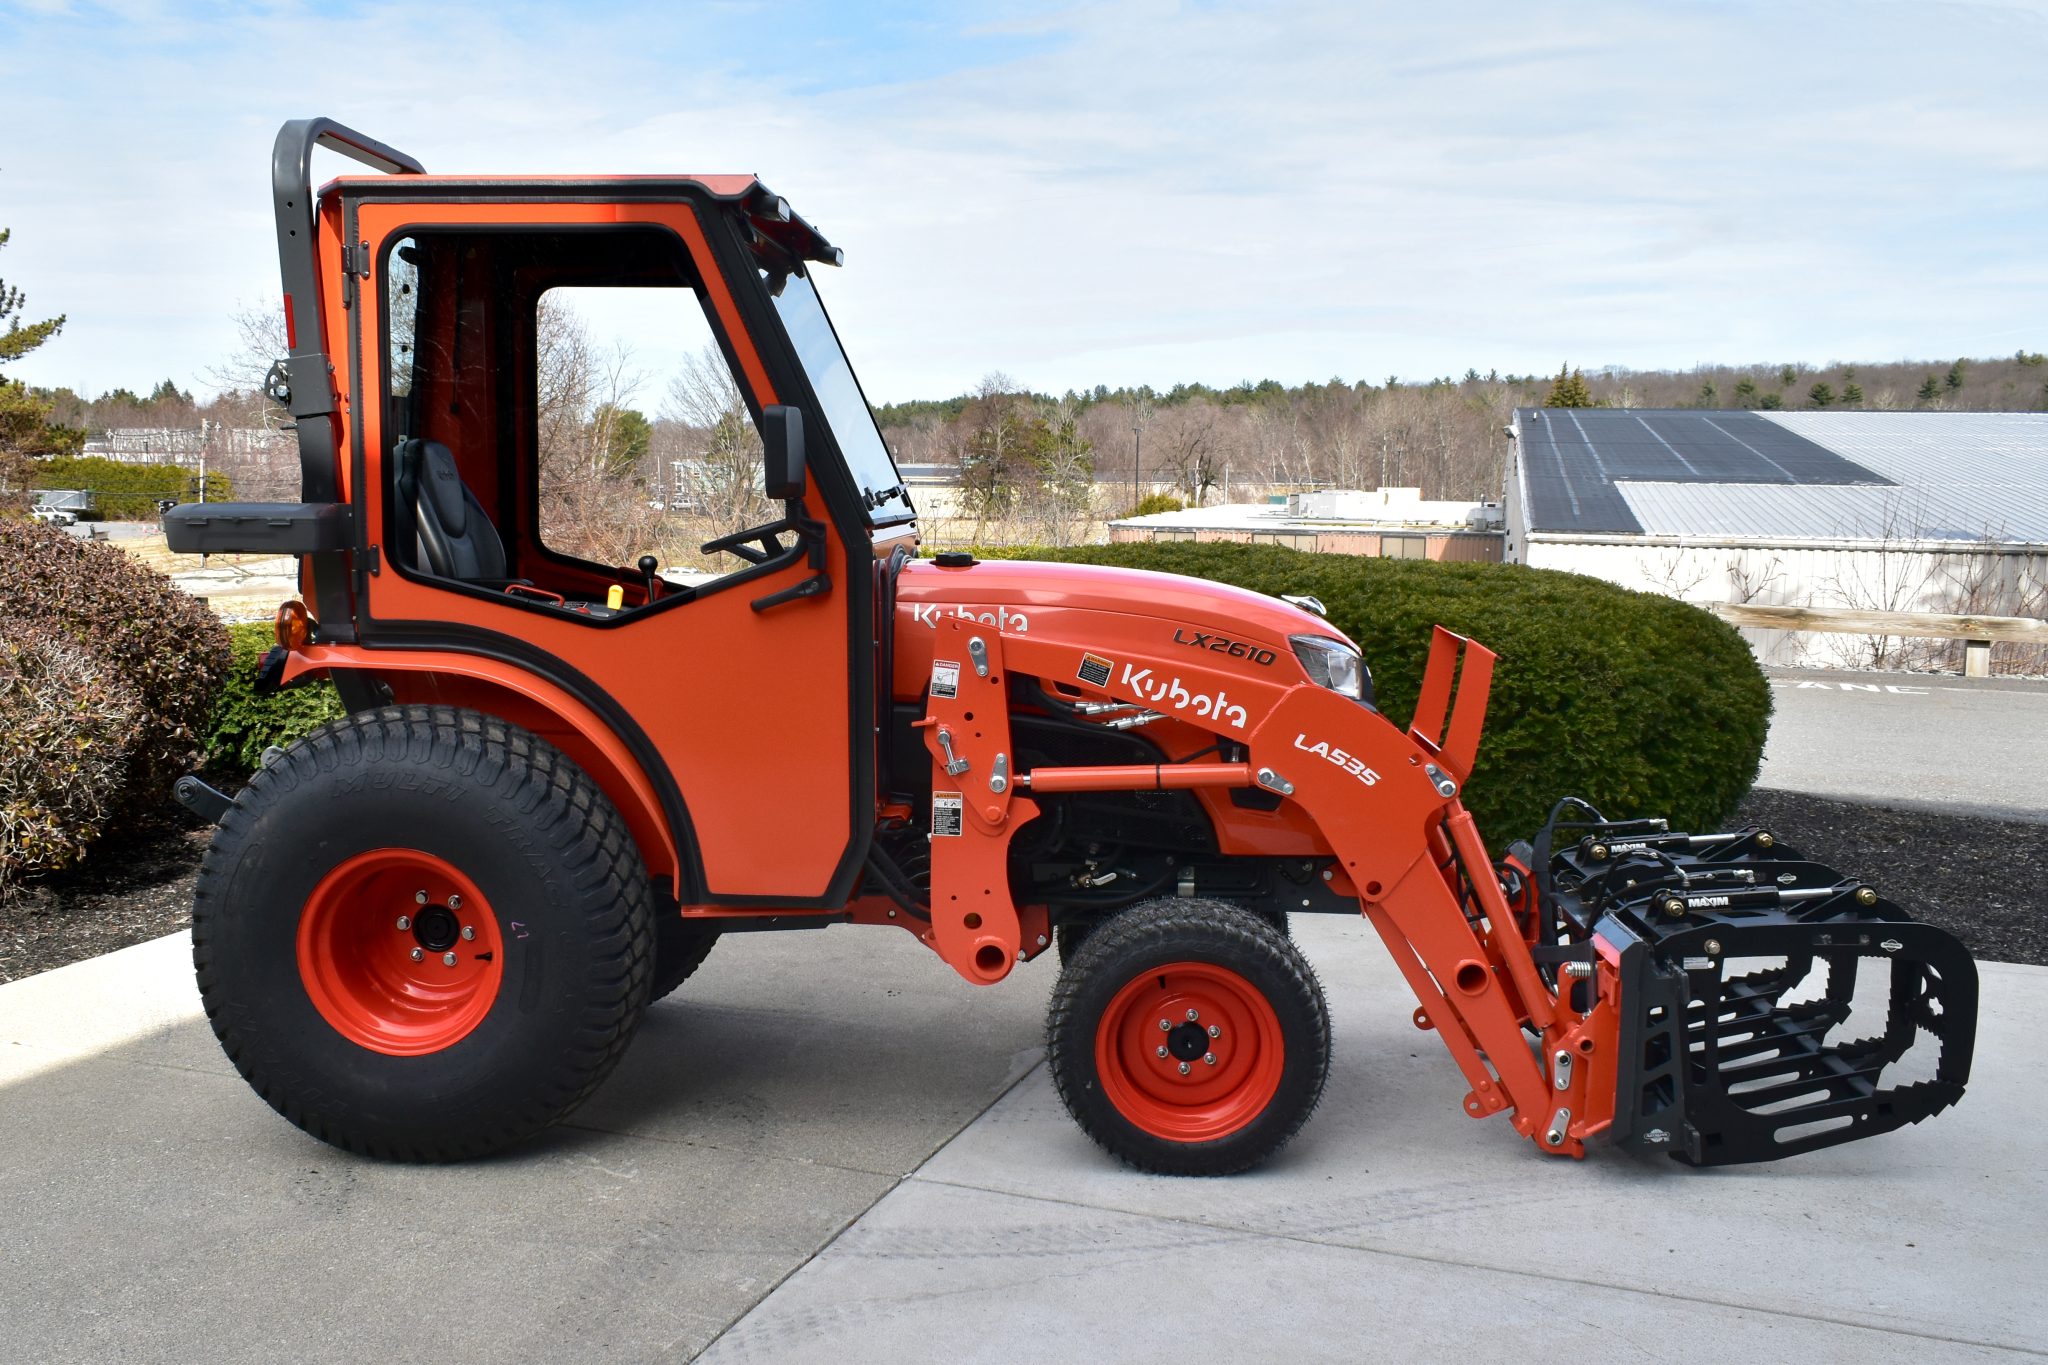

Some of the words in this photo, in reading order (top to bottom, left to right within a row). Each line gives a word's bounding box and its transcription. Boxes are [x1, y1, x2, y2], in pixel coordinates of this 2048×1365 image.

[1173, 628, 1277, 666] LX2610
[1121, 663, 1247, 728] Kubota
[1294, 733, 1382, 786] LA535
[334, 771, 468, 801] MULTI
[1611, 842, 1647, 853] MAXIM
[1688, 896, 1729, 908] MAXIM
